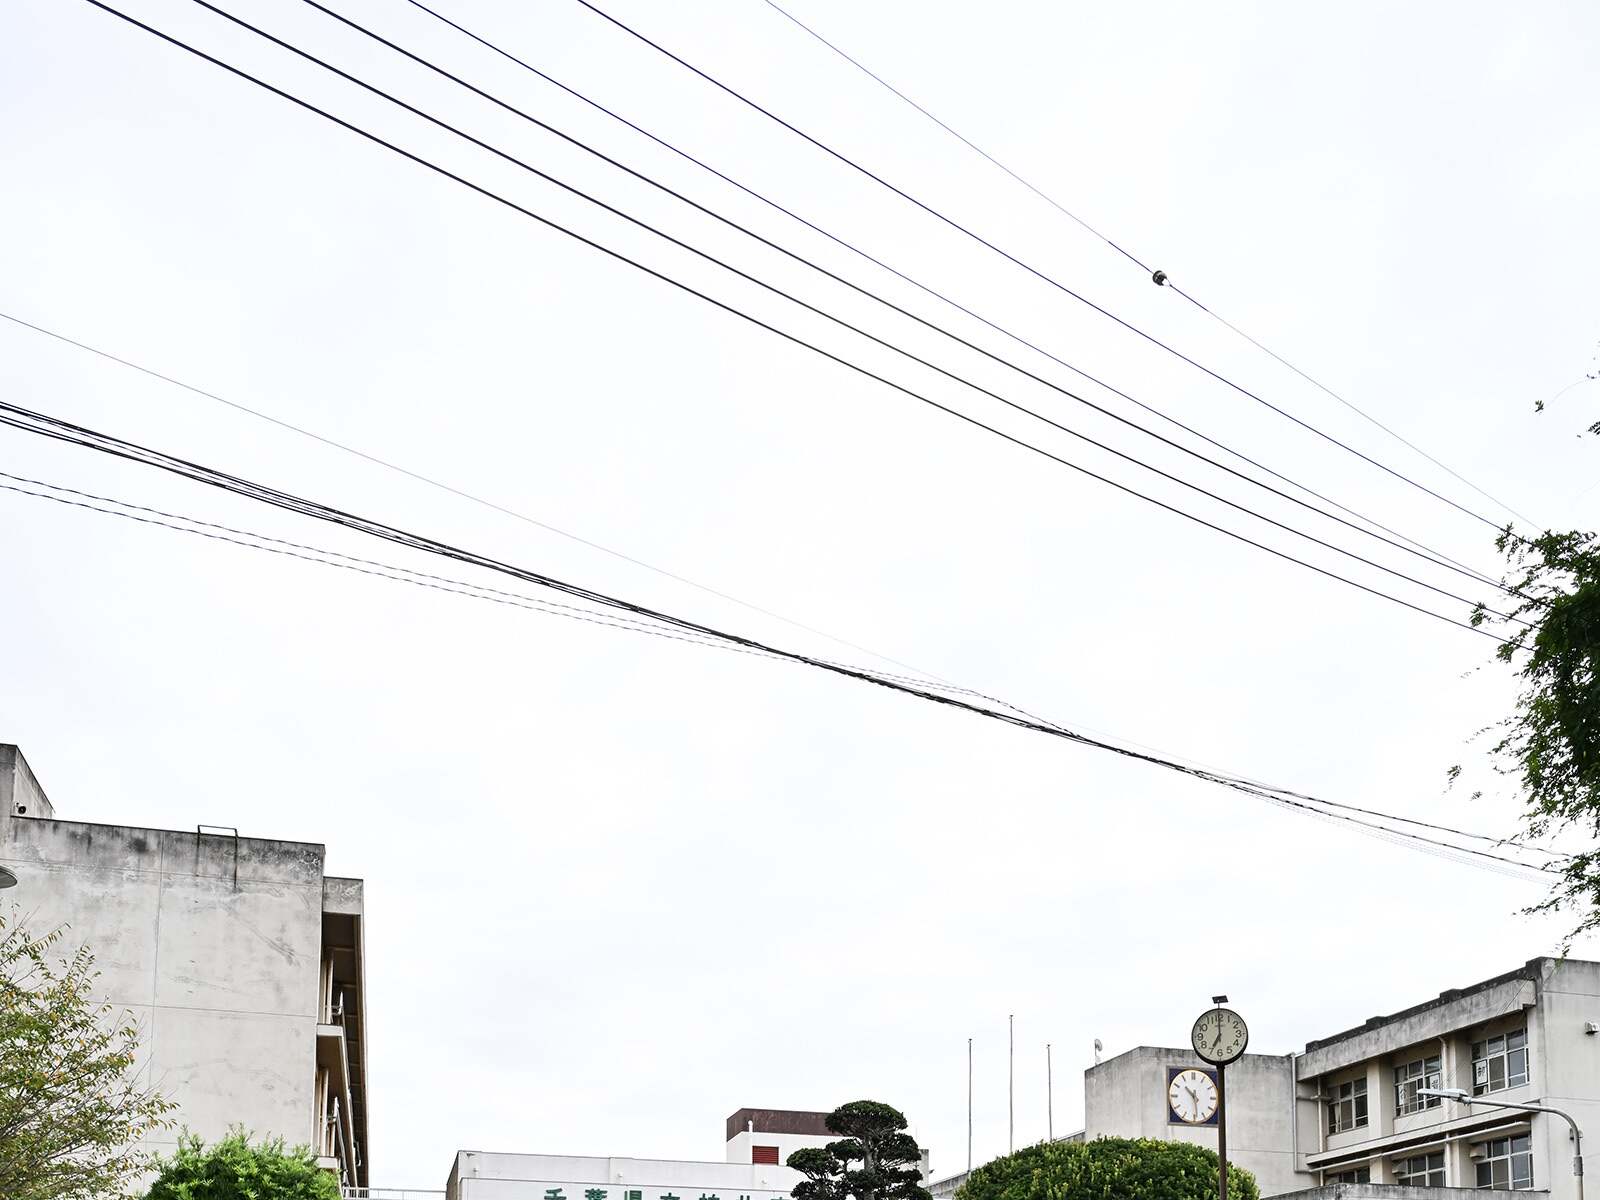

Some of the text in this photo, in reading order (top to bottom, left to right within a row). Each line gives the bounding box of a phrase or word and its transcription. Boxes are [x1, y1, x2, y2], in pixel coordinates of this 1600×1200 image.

[1206, 1015, 1214, 1024] 11
[1200, 1023, 1208, 1031] 10
[1233, 1021, 1239, 1029] 2
[1197, 1033, 1203, 1041] 9
[1235, 1030, 1242, 1038] 3
[1201, 1040, 1207, 1049] 8
[1209, 1047, 1214, 1055] 7
[1217, 1049, 1223, 1057] 6
[1226, 1046, 1232, 1054] 5
